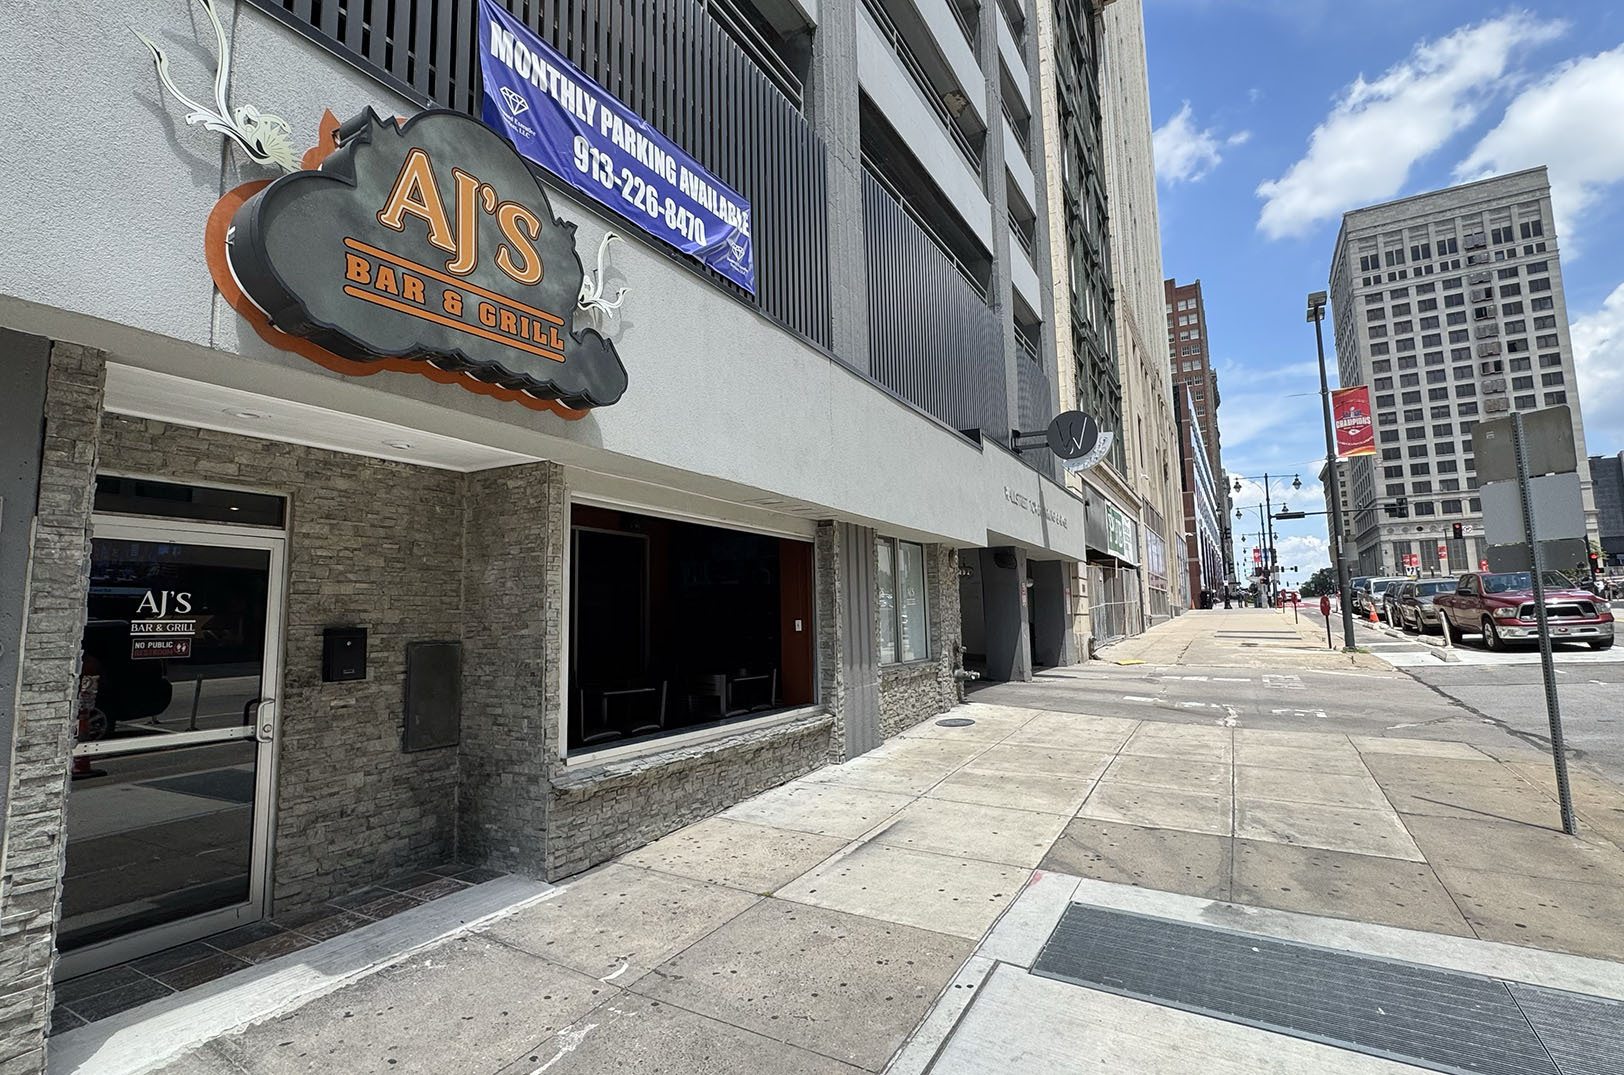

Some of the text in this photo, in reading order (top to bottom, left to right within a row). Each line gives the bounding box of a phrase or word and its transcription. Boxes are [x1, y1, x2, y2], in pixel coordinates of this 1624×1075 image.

[490, 20, 750, 237] MONTHLY PARKING AVAILABLE
[376, 147, 544, 287] AJ'S
[573, 135, 707, 247] 913-226-8470
[344, 251, 566, 352] BAR & GRILL
[131, 623, 195, 632] BAR & GRILL
[135, 641, 173, 649] NO PUBLIC
[136, 590, 192, 619] AJ'S
